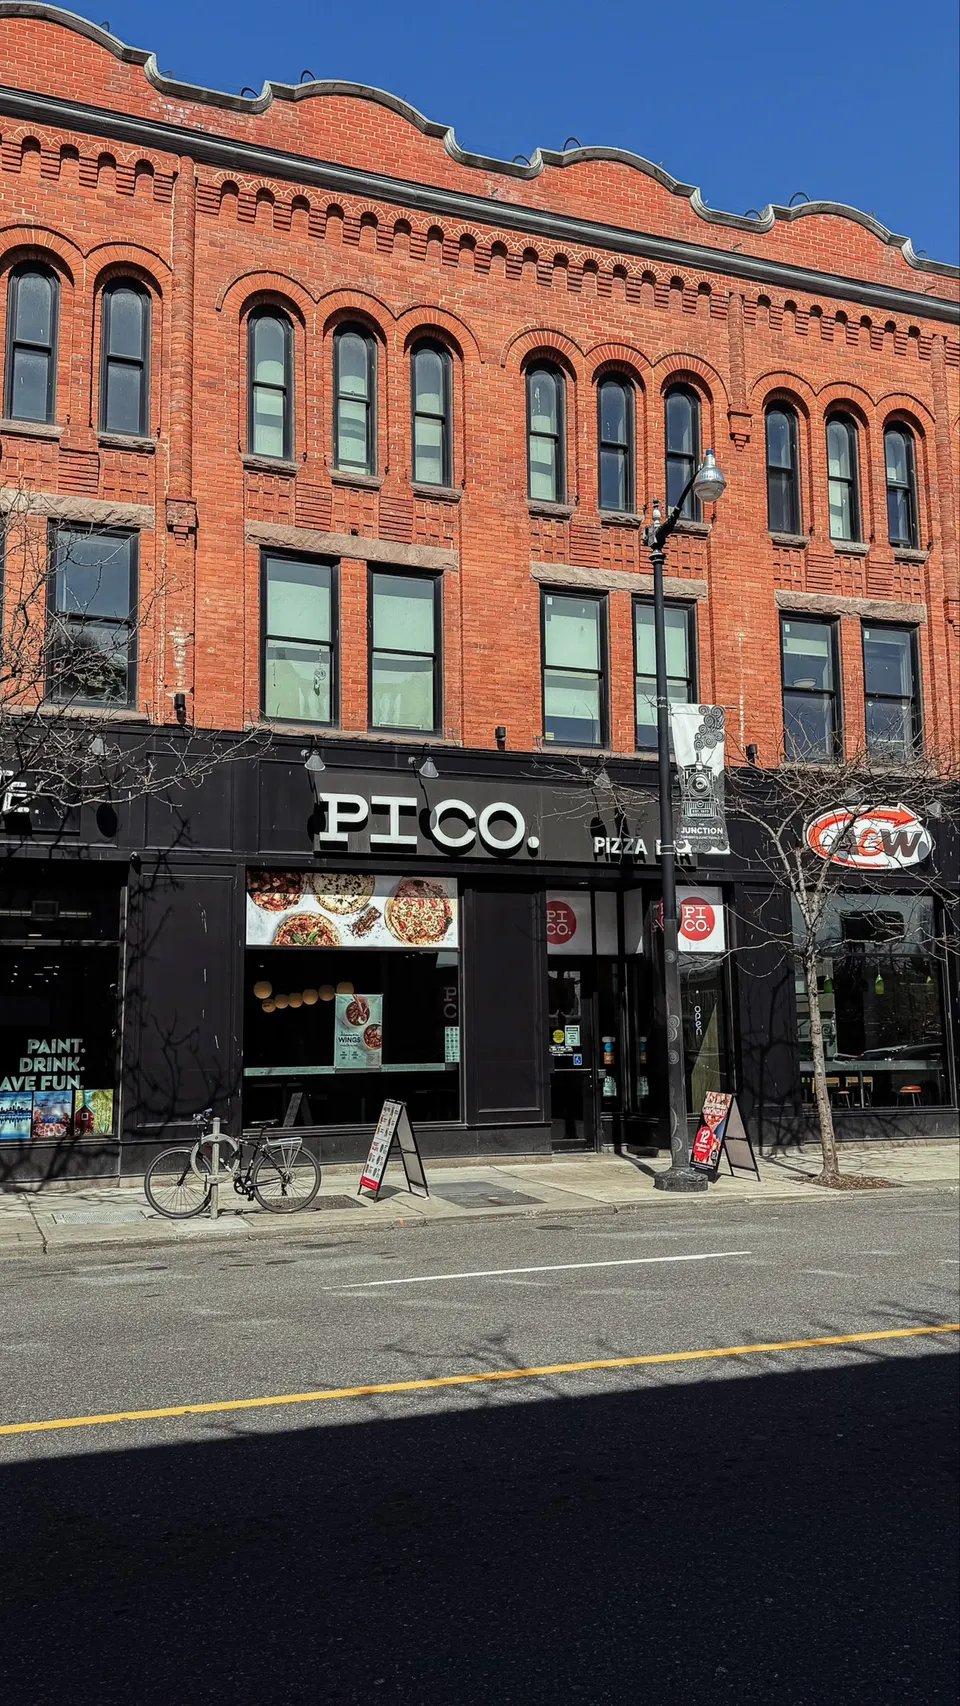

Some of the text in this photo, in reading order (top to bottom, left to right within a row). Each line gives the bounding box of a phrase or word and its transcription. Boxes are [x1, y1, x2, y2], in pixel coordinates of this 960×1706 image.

[319, 793, 540, 850] PICO.
[593, 836, 648, 855] PIZZA
[546, 910, 568, 923] PI
[684, 906, 706, 919] PI
[546, 923, 572, 935] CO.
[684, 919, 711, 932] CO.
[27, 1038, 86, 1054] PAINT.
[19, 1056, 86, 1073] DRINK.
[40, 1074, 85, 1091] FUN.
[700, 1129, 711, 1143] 12
